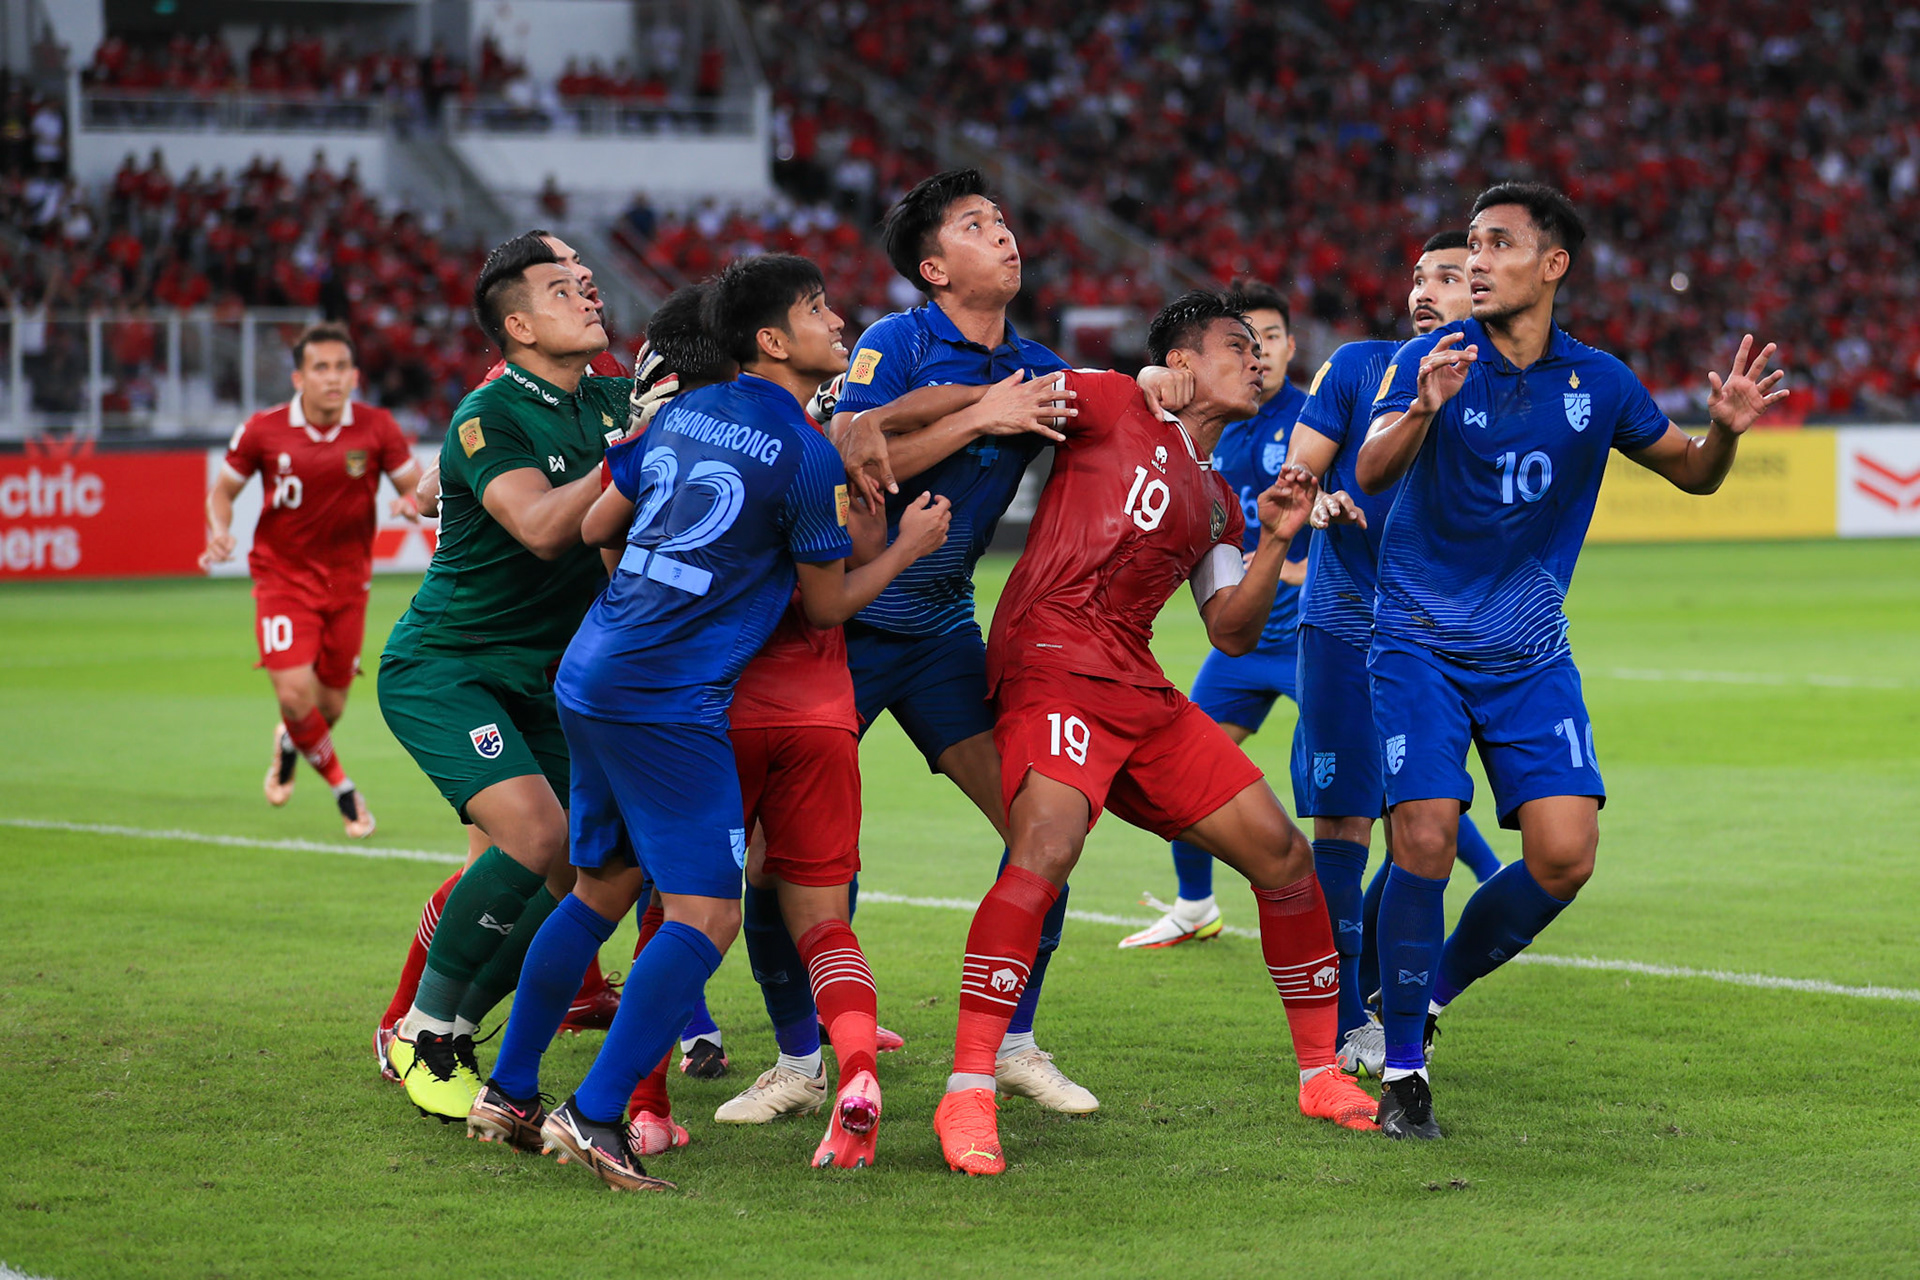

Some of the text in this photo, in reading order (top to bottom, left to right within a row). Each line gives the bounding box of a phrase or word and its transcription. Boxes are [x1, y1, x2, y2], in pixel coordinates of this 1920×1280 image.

[662, 407, 784, 467] CHANNARONG
[0, 462, 104, 519] ctric
[272, 473, 303, 509] 10
[1123, 464, 1171, 532] 19
[1495, 450, 1553, 504] 10
[0, 526, 81, 571] ers
[617, 445, 746, 597] 22
[262, 614, 293, 654] 10
[1047, 712, 1091, 767] 19
